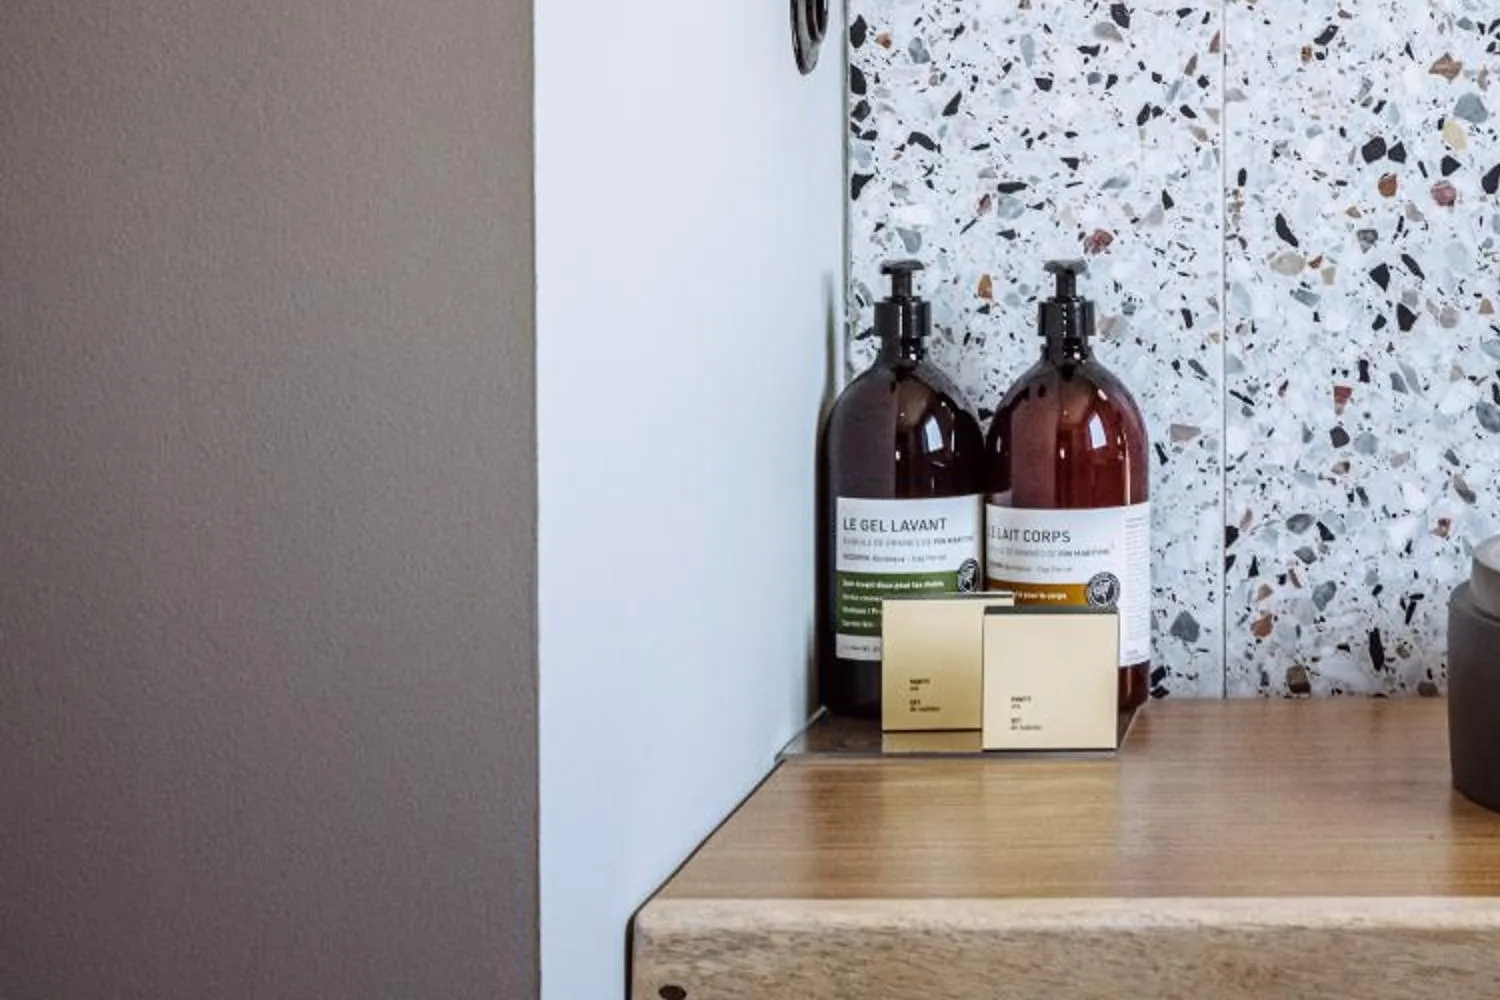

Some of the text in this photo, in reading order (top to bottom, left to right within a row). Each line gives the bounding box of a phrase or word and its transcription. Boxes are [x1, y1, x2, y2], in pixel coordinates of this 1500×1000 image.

[842, 517, 948, 533] LE GEL LAVANT
[1022, 529, 1072, 544] CORPS
